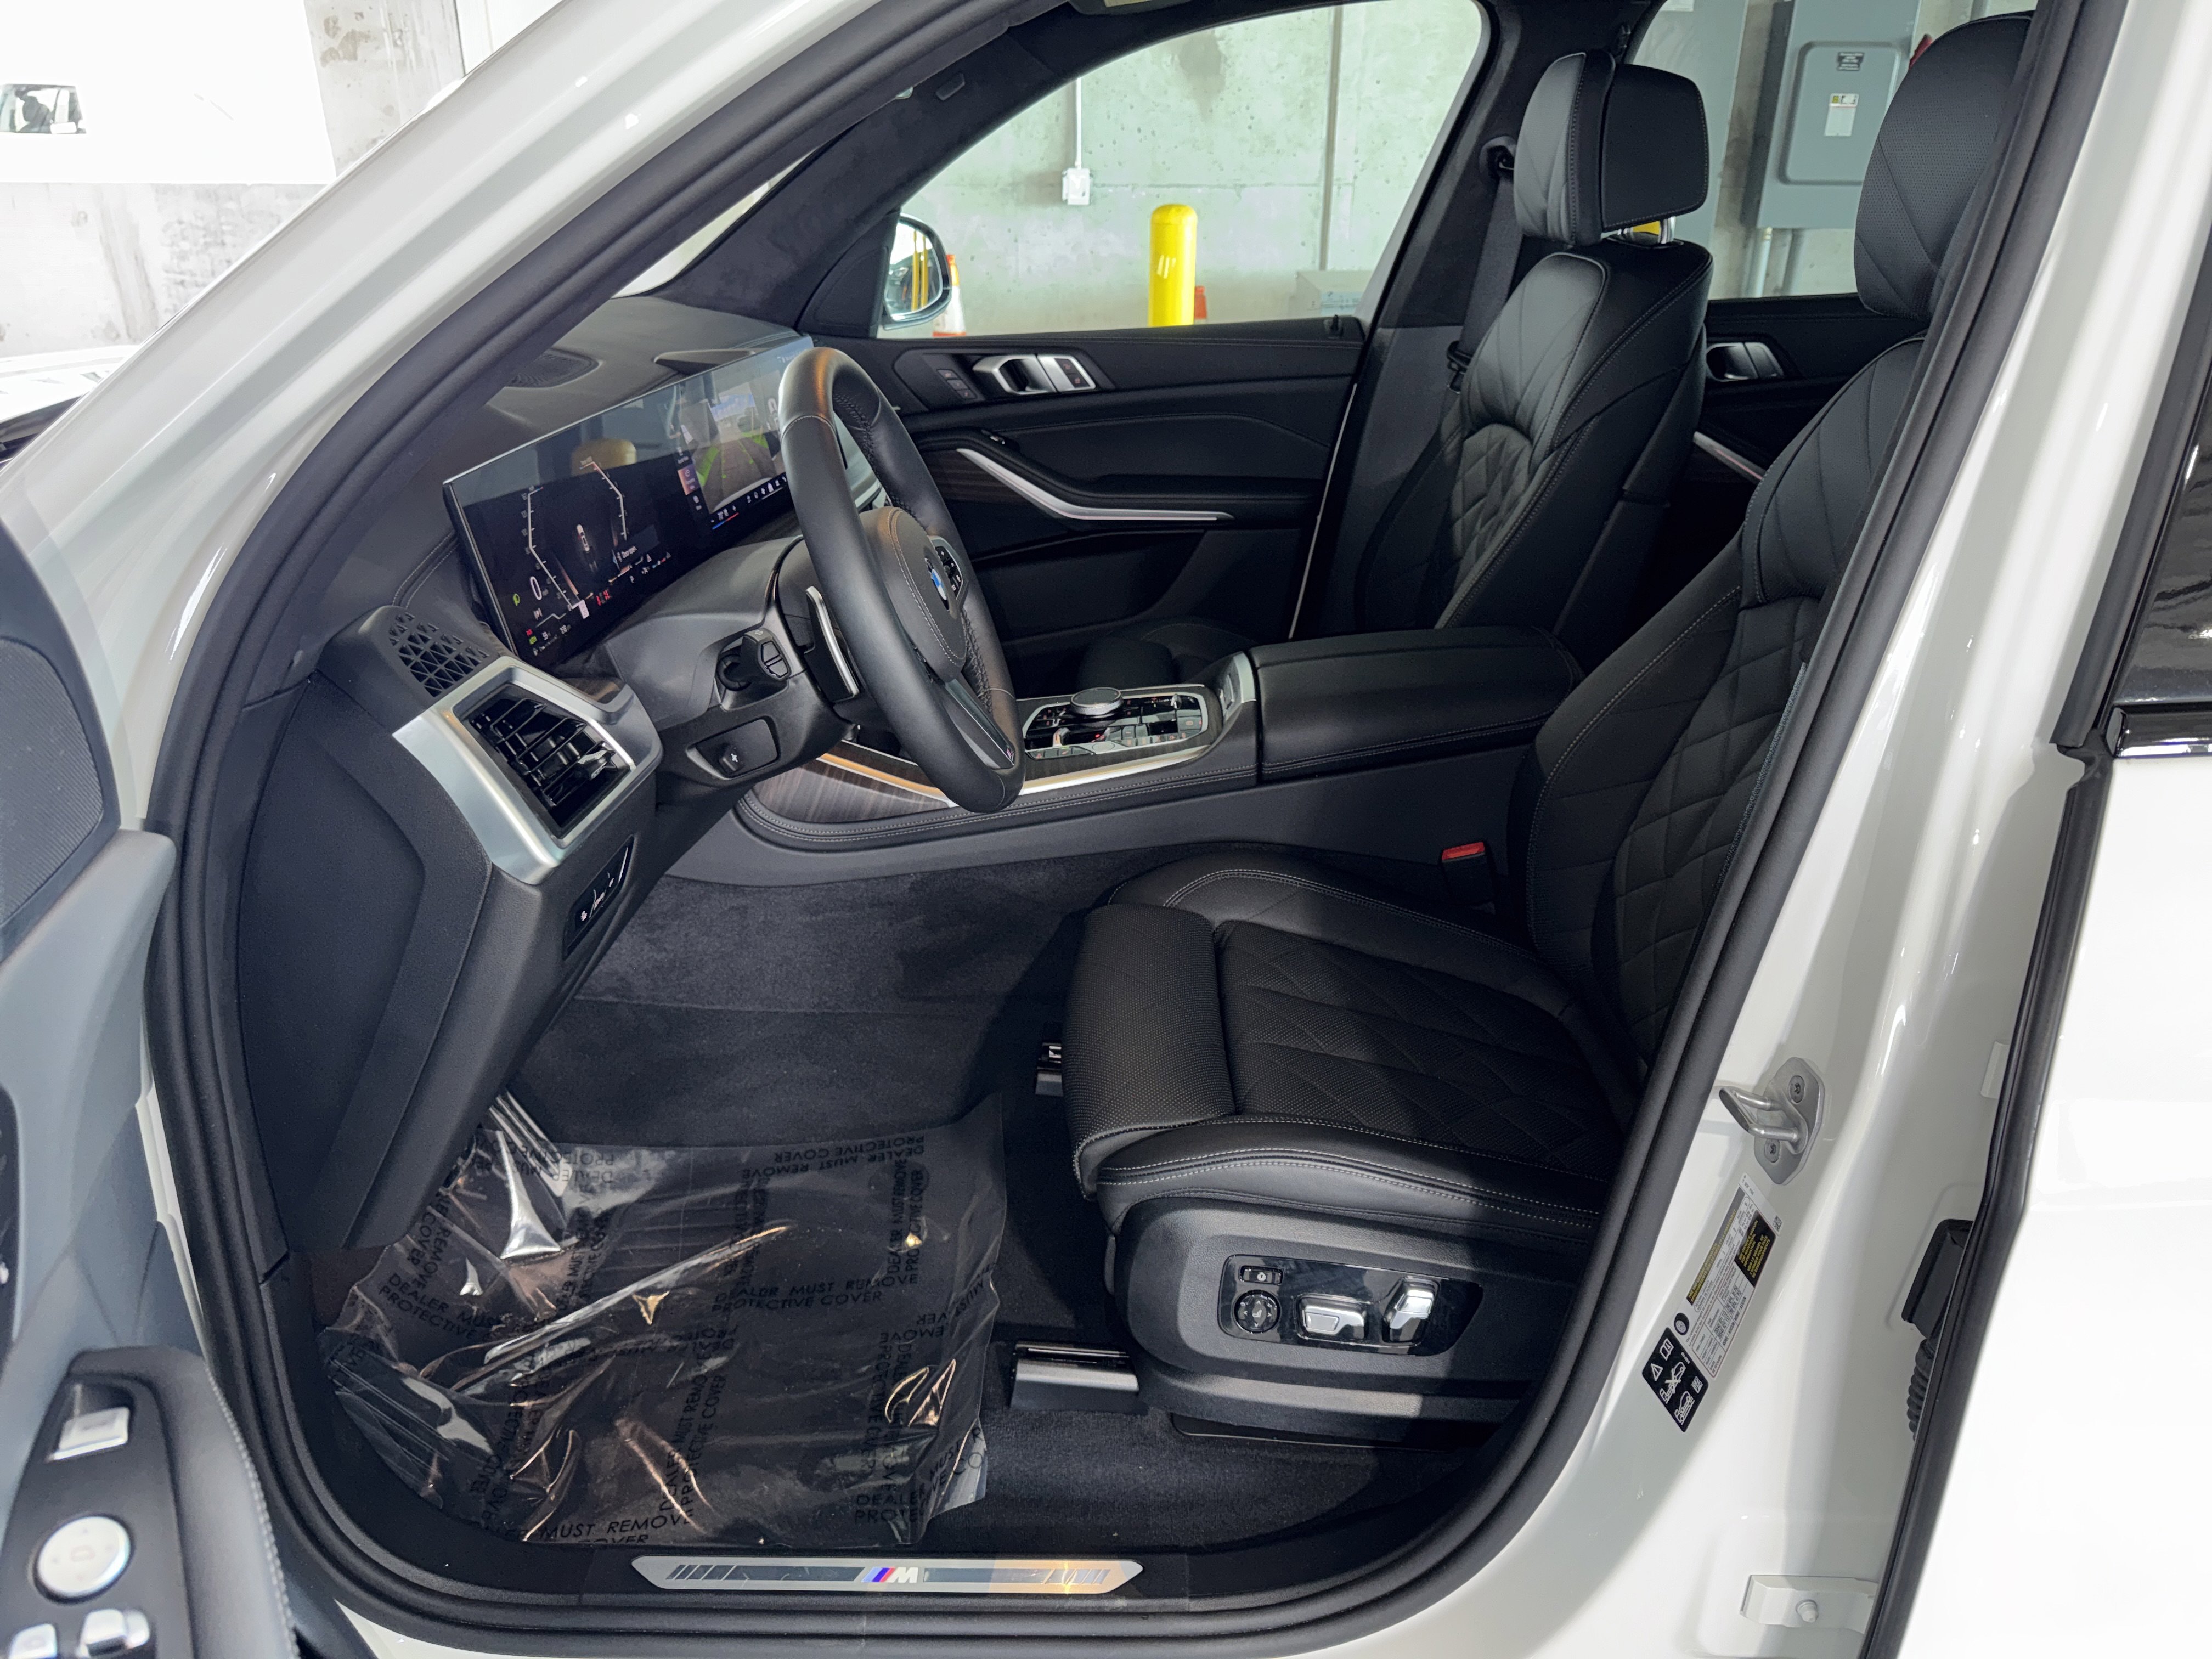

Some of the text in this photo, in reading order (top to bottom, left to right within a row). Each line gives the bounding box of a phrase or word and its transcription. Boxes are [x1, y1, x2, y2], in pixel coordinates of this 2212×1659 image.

[742, 1145, 925, 1180] DEALER MUST REMOVE
[774, 1136, 924, 1163] PROTECTIVE COVER
[887, 1159, 907, 1274] DEALER MUST REMOVE
[906, 1170, 923, 1272] PROCTIVE COVER
[407, 1211, 436, 1266] COVER
[412, 1228, 452, 1289] REMOVE
[388, 1273, 449, 1313] DEALER
[711, 1291, 882, 1313] PROTECTIVE COVER
[788, 1281, 835, 1295] MUST
[845, 1273, 918, 1291] REMOVE
[379, 1285, 477, 1339] PROTECTIVE
[880, 1324, 945, 1344] EMOVE
[701, 1375, 726, 1419] COVER
[670, 1417, 694, 1443] MUST
[539, 1523, 596, 1539] MUST
[606, 1514, 692, 1534] REMOVE
